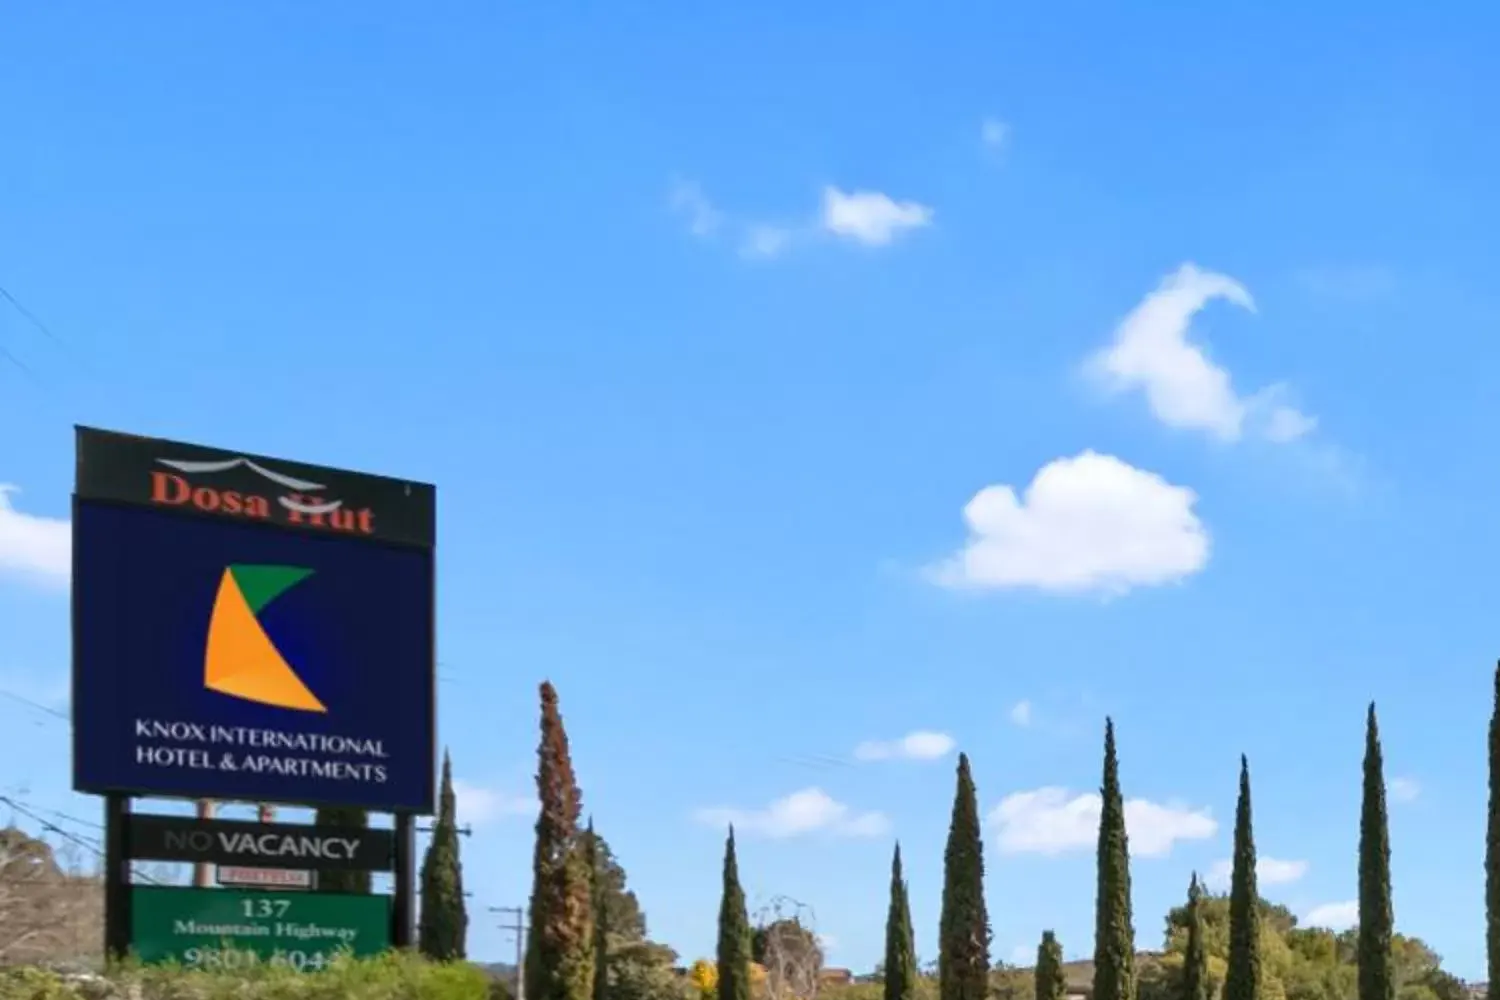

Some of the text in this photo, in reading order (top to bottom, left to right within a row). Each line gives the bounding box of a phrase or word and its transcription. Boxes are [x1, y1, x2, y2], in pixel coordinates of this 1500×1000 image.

[151, 471, 375, 533] Dosa Hut
[136, 719, 388, 757] KNOX INTERNATIONAL
[136, 747, 388, 782] HOTEL & APARTMENTS
[165, 830, 361, 859] NO VACANCY
[243, 899, 291, 918] 137
[174, 920, 358, 941] Mountain Highway
